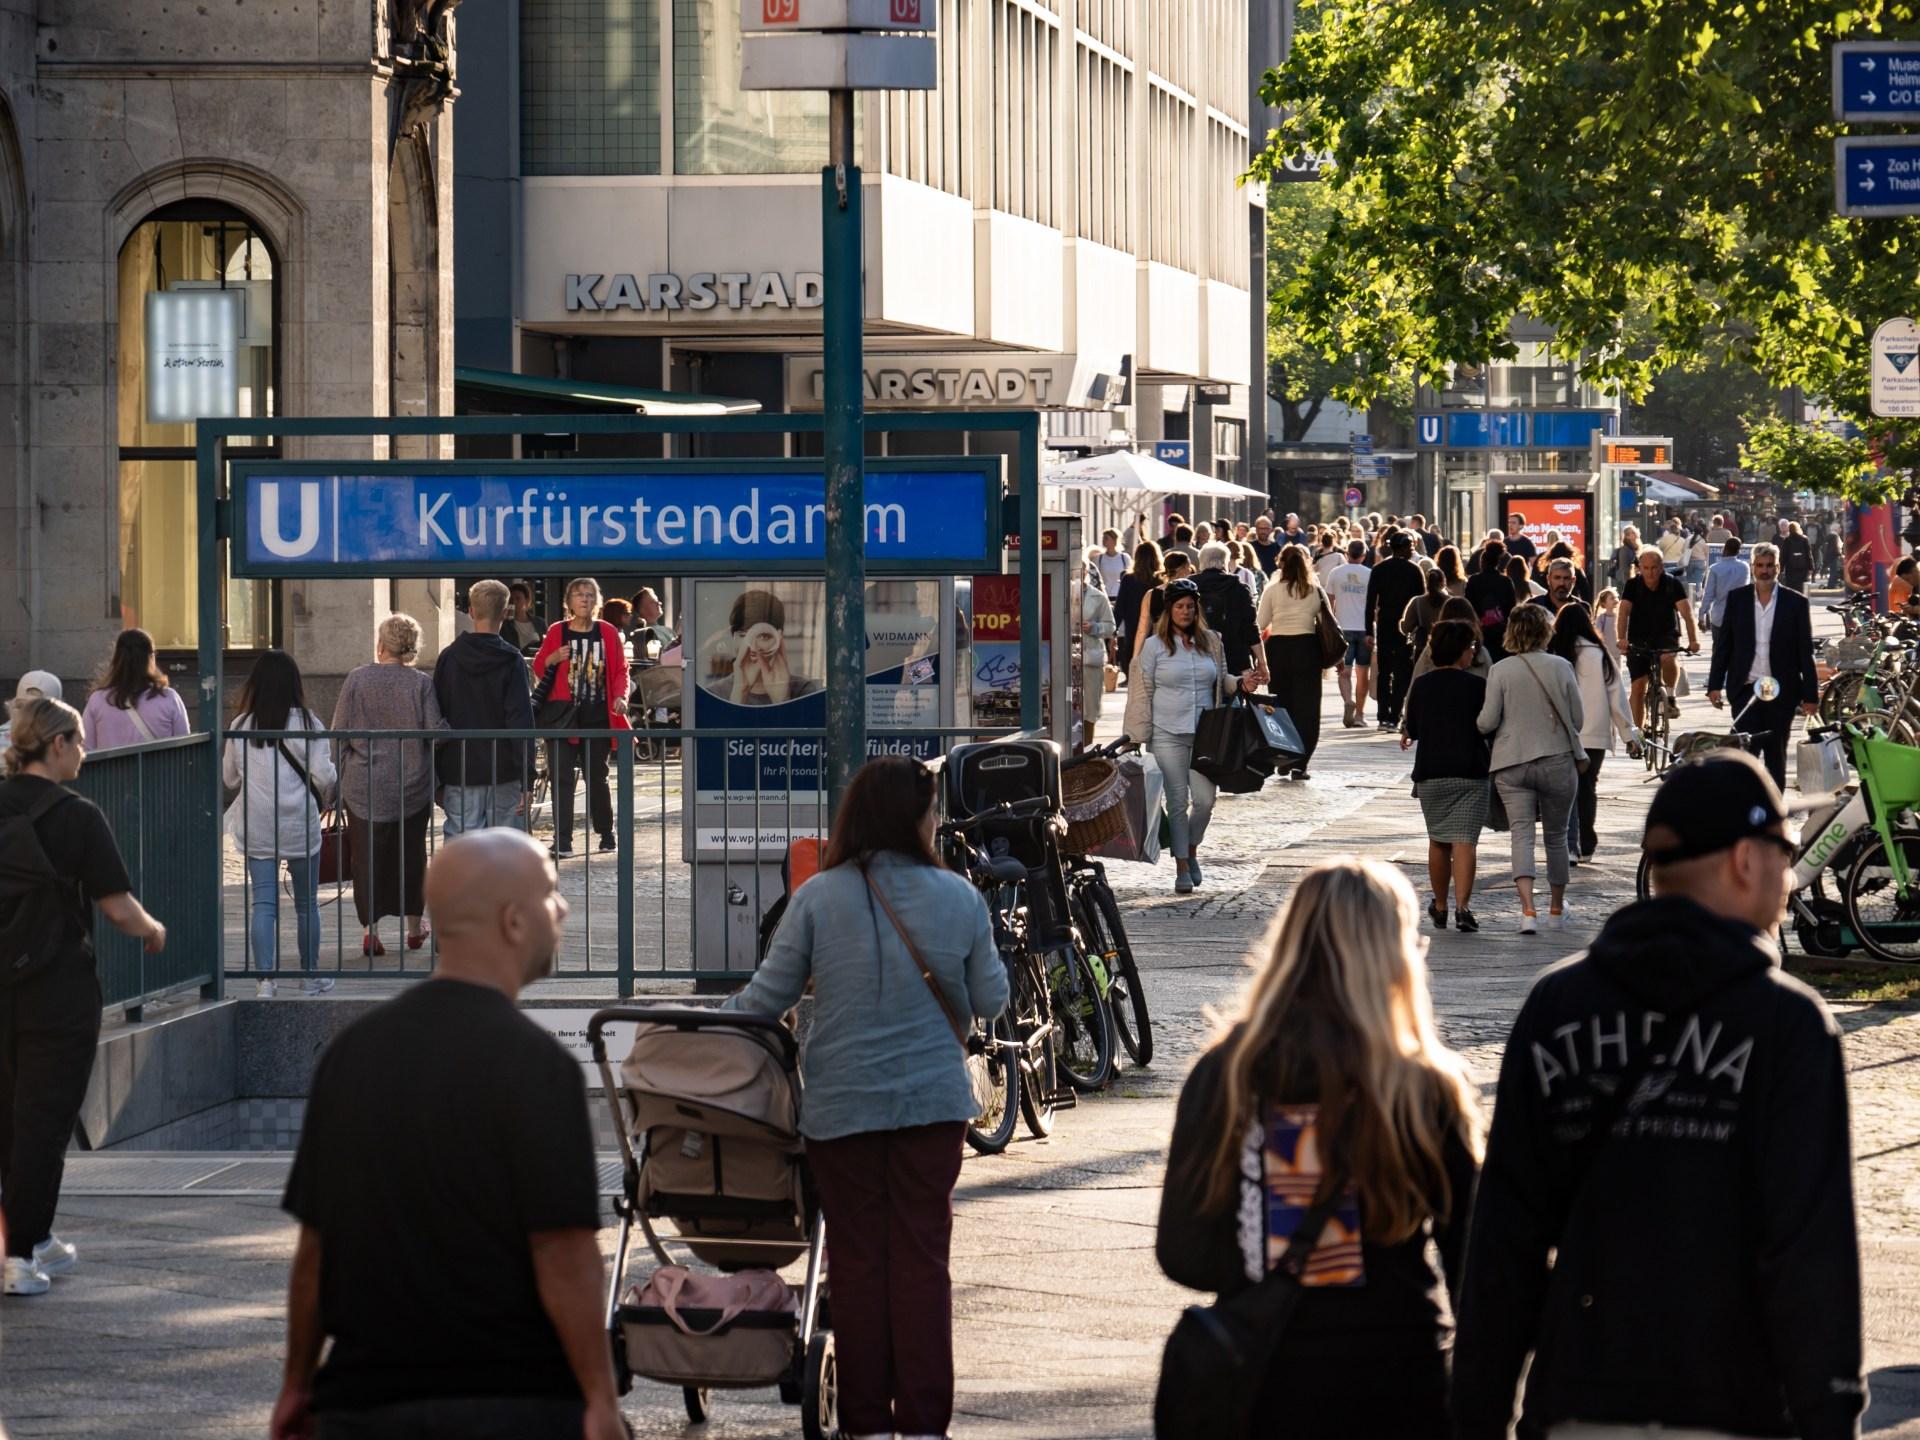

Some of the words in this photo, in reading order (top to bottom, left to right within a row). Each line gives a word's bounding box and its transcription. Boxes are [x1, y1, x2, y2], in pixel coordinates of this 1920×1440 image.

[1888, 90, 1912, 104] C/O
[1887, 158, 1910, 172] Zoo
[565, 272, 824, 311] KARSTAD
[812, 368, 1052, 401] RSTADT
[1423, 418, 1438, 442] U
[259, 482, 320, 558] U
[873, 632, 929, 641] WIDMANN
[728, 740, 754, 756] Sie
